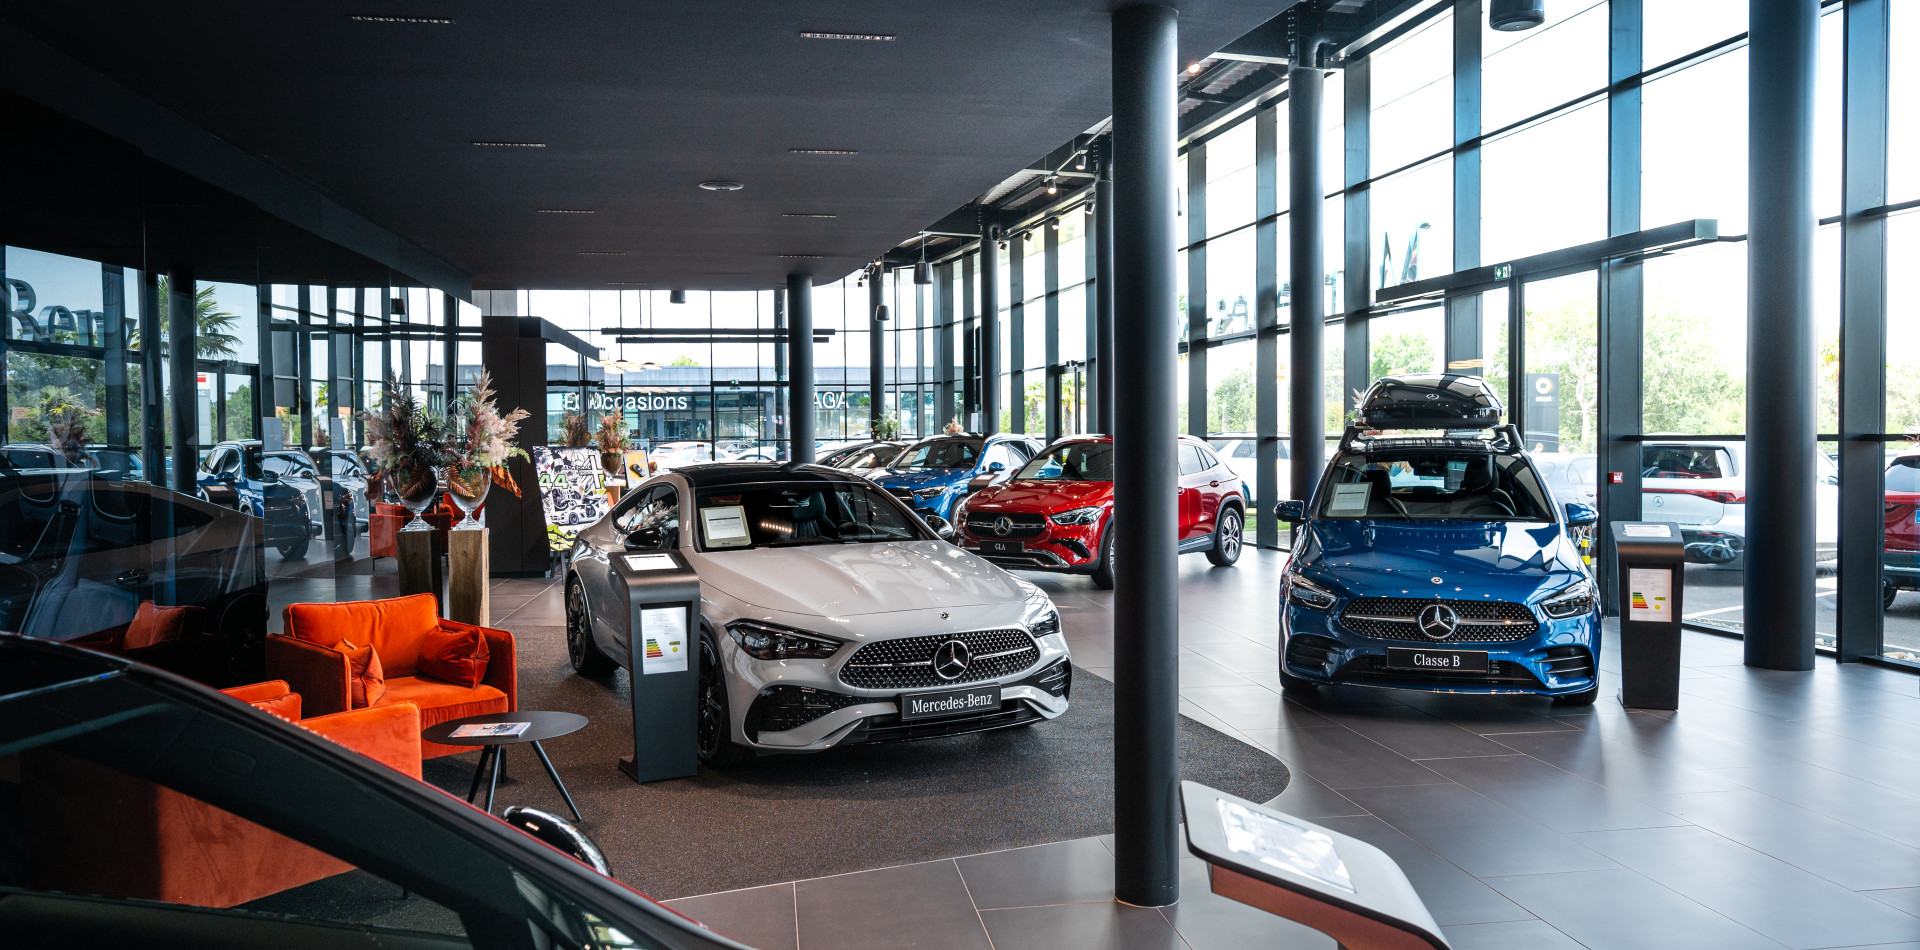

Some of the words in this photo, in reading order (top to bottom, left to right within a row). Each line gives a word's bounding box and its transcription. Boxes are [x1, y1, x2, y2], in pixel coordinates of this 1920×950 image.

[603, 392, 688, 411] ccasions
[539, 473, 569, 490] 44
[994, 543, 1006, 551] GLA
[1413, 653, 1450, 667] Classe
[1452, 655, 1461, 667] B
[911, 693, 993, 714] Mercedes-Benz
